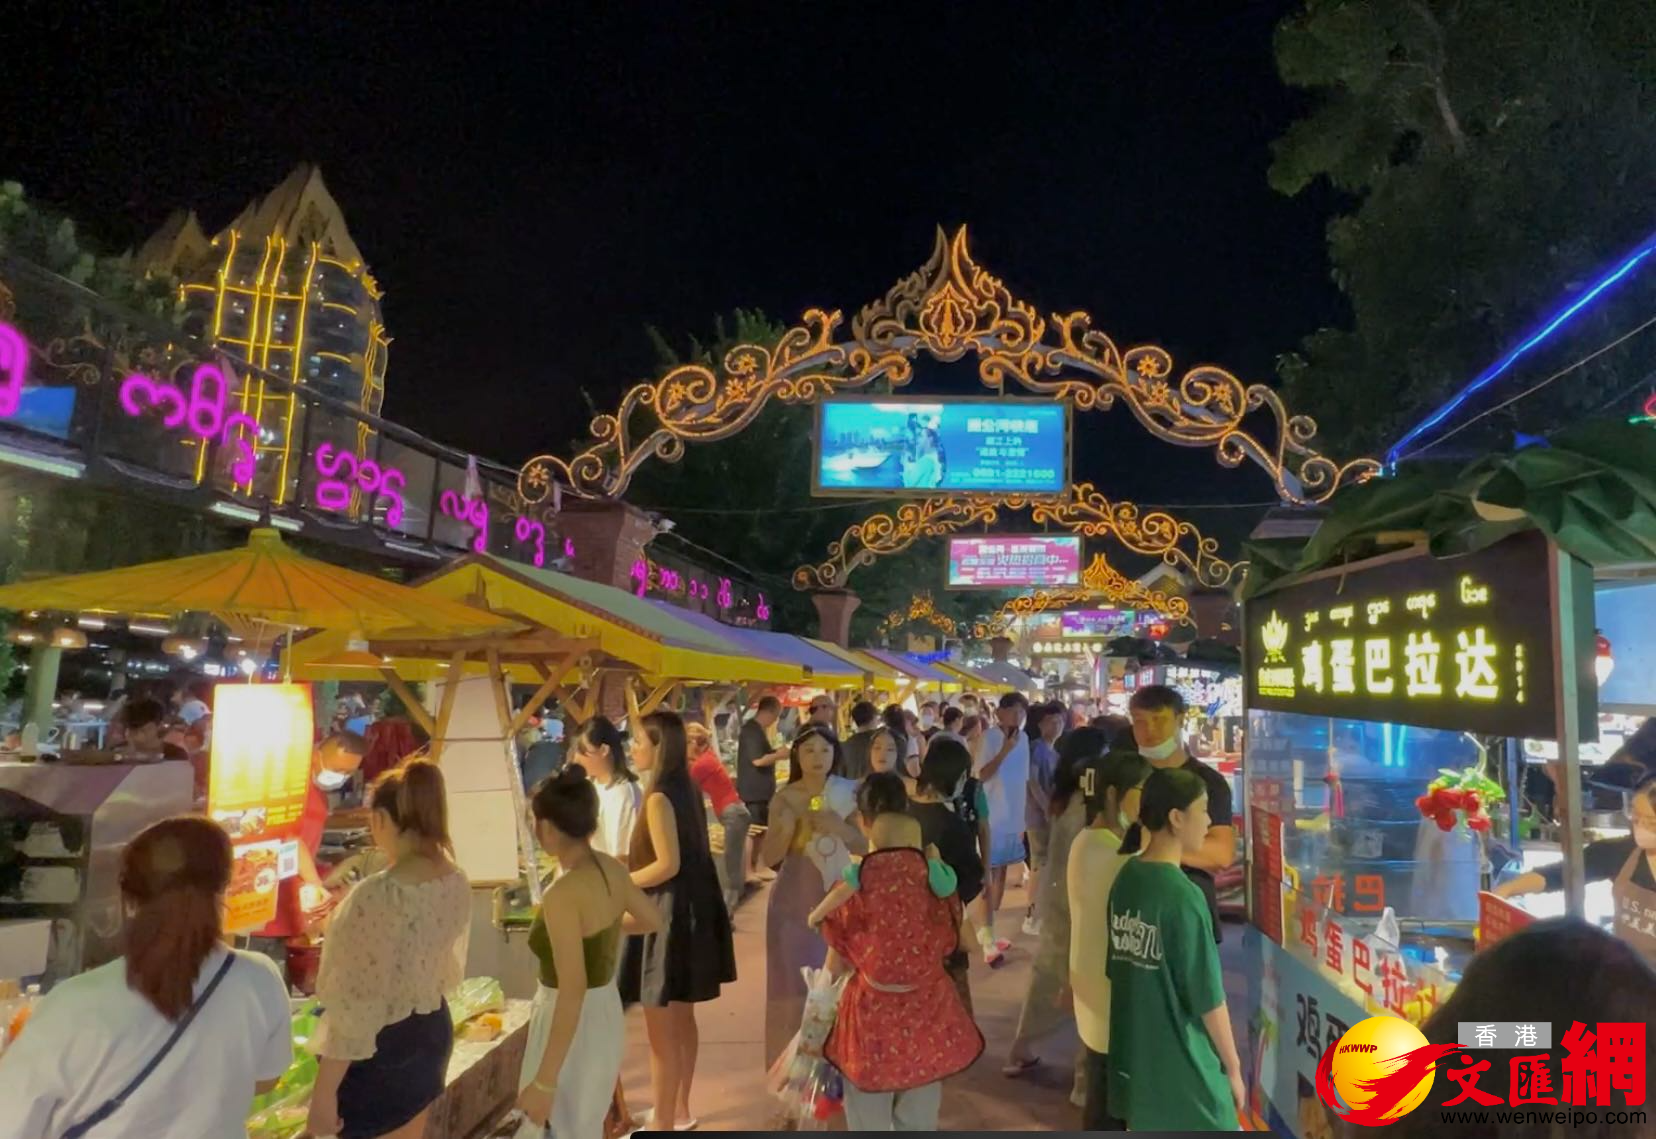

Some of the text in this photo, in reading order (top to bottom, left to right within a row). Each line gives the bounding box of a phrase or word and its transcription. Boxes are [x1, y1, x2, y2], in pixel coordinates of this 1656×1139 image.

[1301, 626, 1499, 699] 鸡蛋巴拉达
